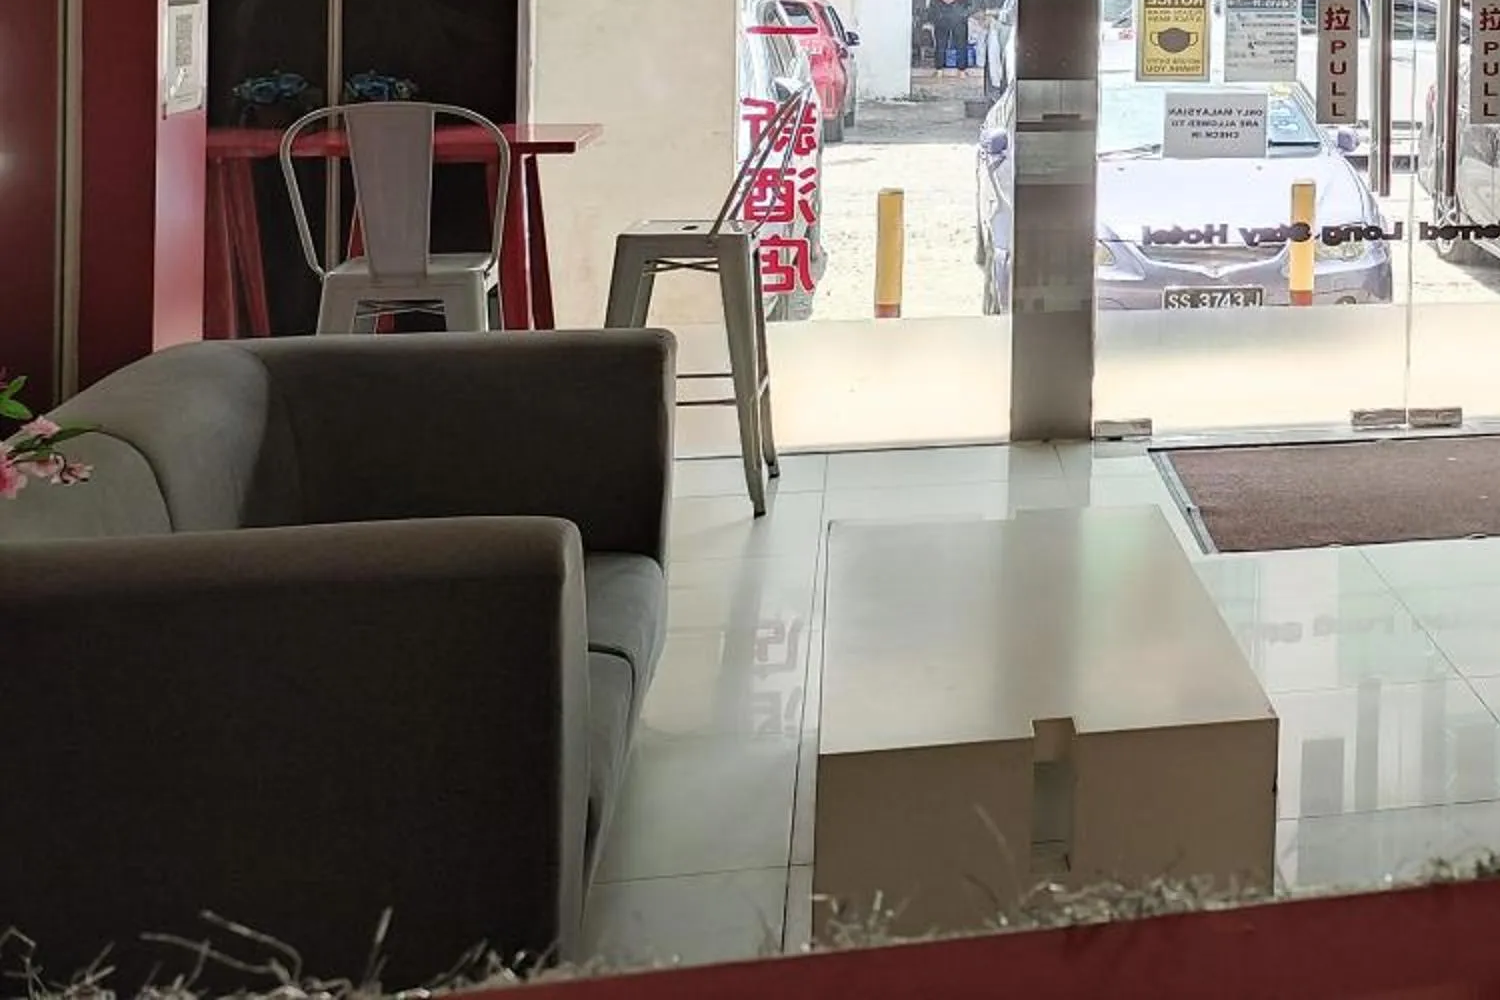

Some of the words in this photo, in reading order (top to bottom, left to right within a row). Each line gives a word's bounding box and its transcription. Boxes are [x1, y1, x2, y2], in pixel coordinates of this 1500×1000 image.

[1323, 5, 1351, 32] 拉
[1329, 39, 1347, 117] PULL
[1483, 41, 1500, 117] PULL
[1168, 293, 1191, 310] SS
[1199, 292, 1245, 308] 3743
